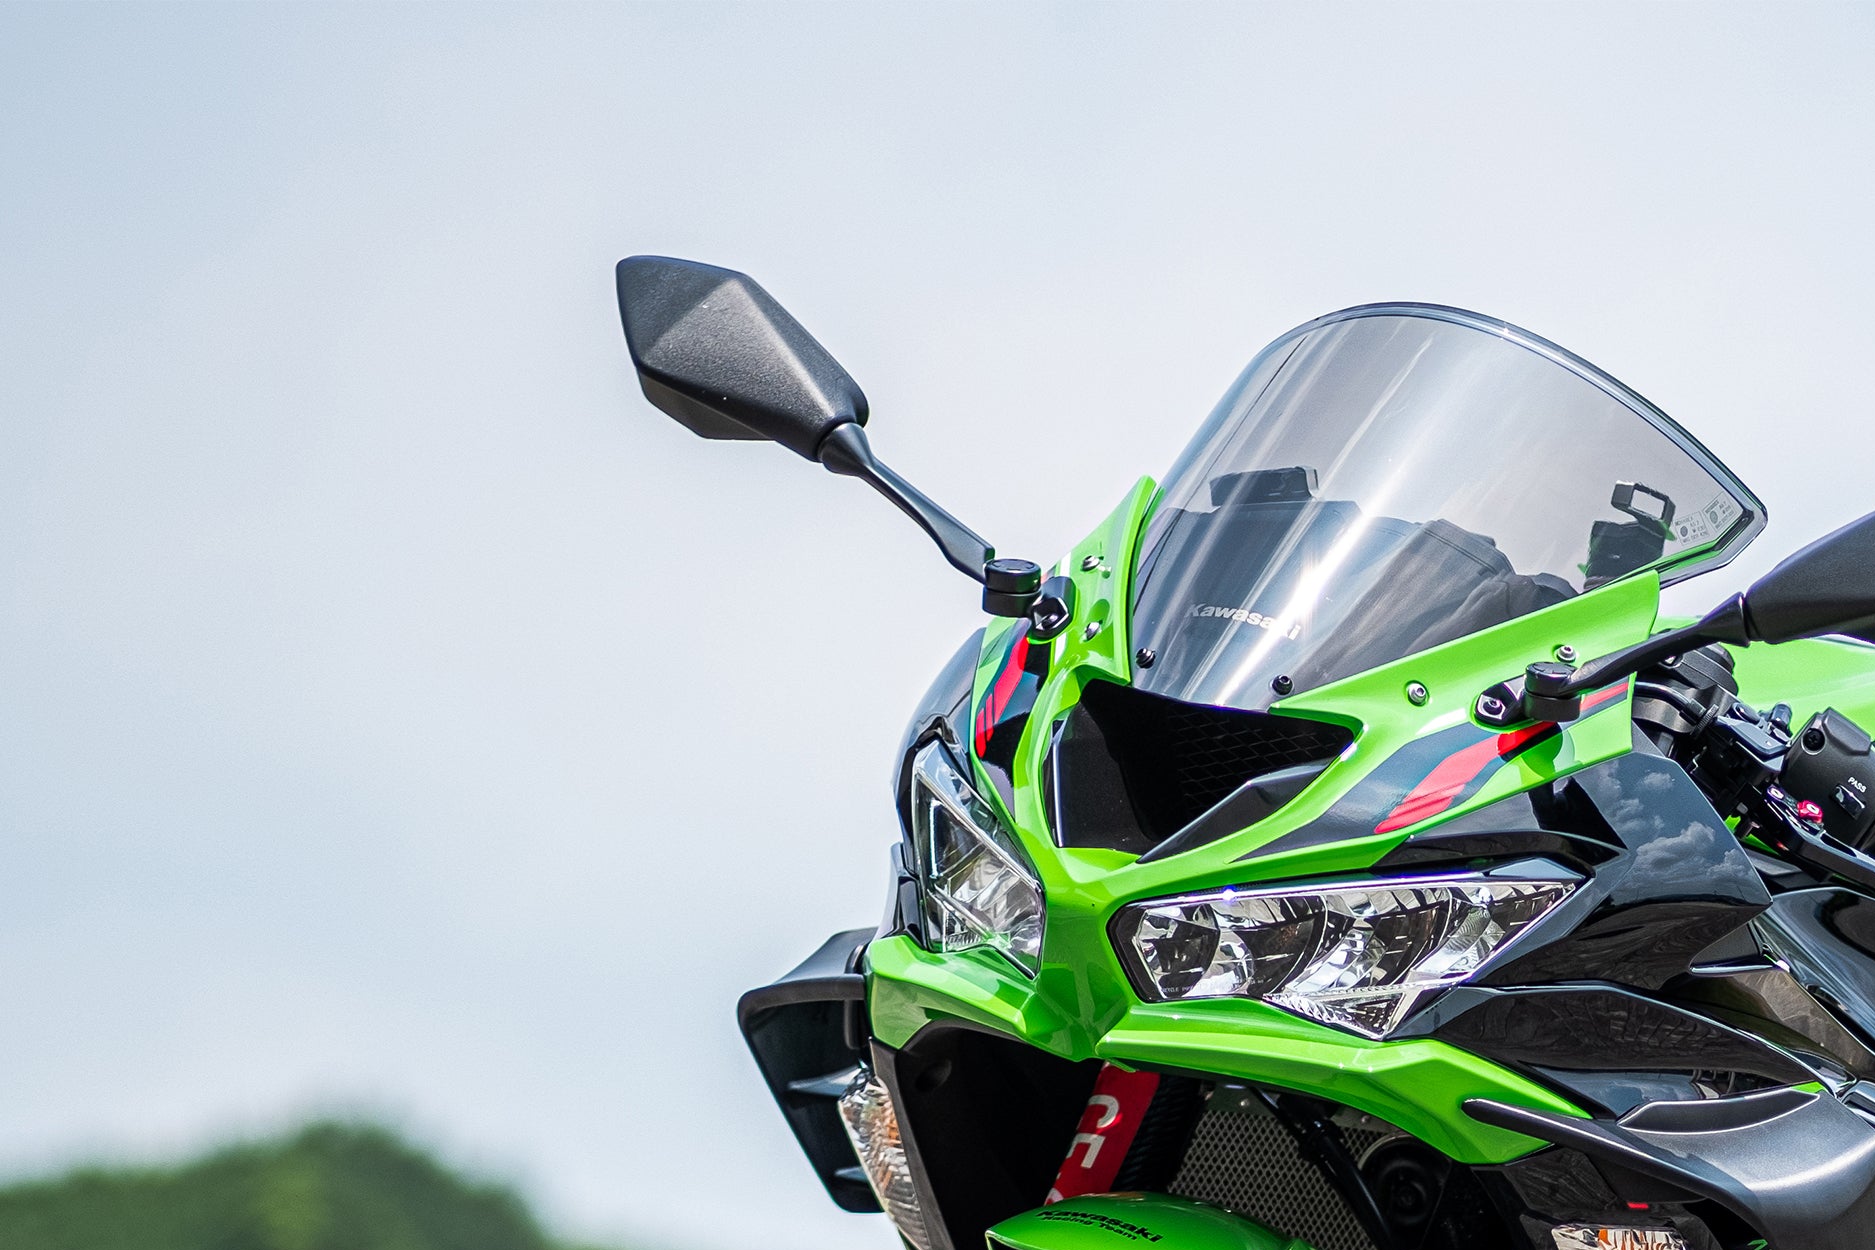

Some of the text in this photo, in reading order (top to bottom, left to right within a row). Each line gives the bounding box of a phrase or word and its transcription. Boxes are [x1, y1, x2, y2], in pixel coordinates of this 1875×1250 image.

[1184, 603, 1300, 640] Kawasai
[1848, 776, 1867, 793] PASS
[1036, 1210, 1163, 1242] Kawasaki
